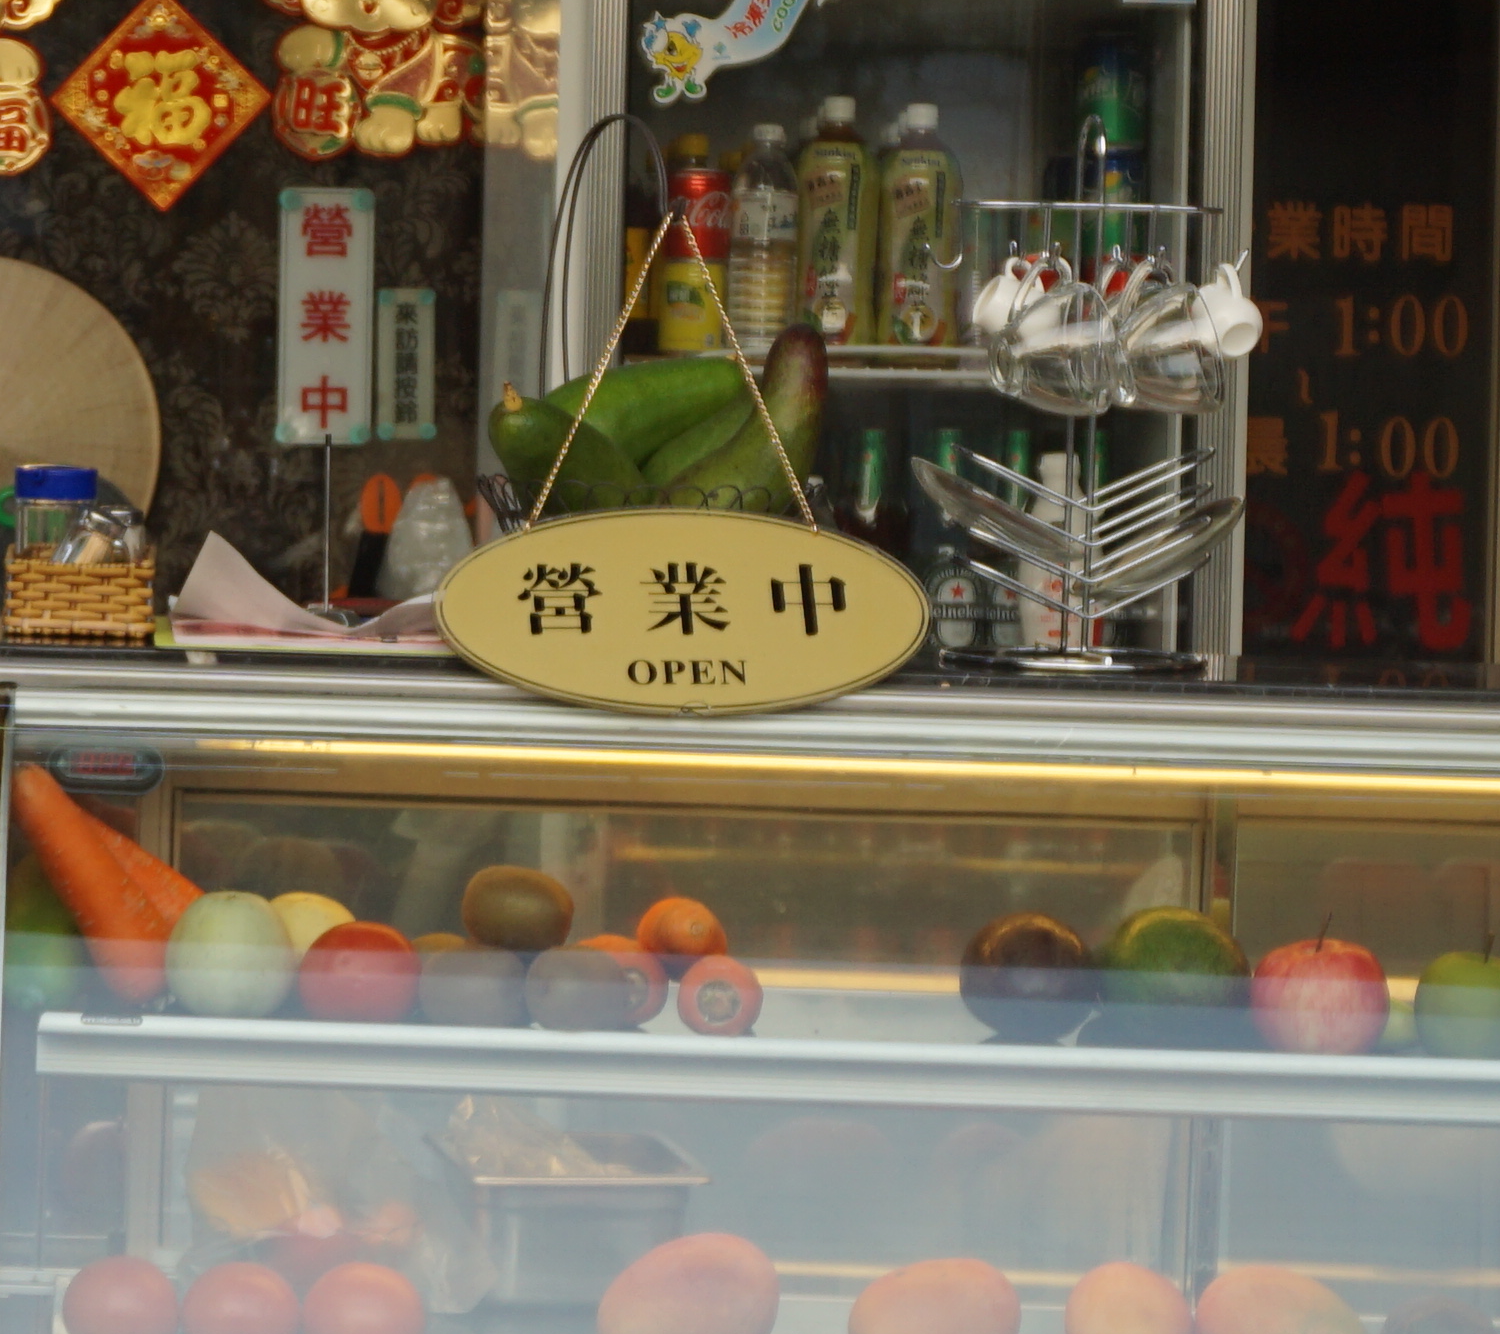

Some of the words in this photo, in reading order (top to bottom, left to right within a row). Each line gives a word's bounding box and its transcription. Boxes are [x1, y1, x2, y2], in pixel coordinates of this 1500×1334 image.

[112, 49, 214, 147] 福
[292, 76, 348, 133] 旺
[1266, 200, 1455, 263] 業時間
[301, 201, 355, 431] 營業中
[1334, 294, 1470, 358] 1:00
[393, 300, 420, 425] 來訪請按鈴
[1318, 411, 1460, 479] 1:00
[1290, 469, 1471, 652] 純
[517, 561, 849, 637] 營業中
[626, 658, 748, 687] OPEN
